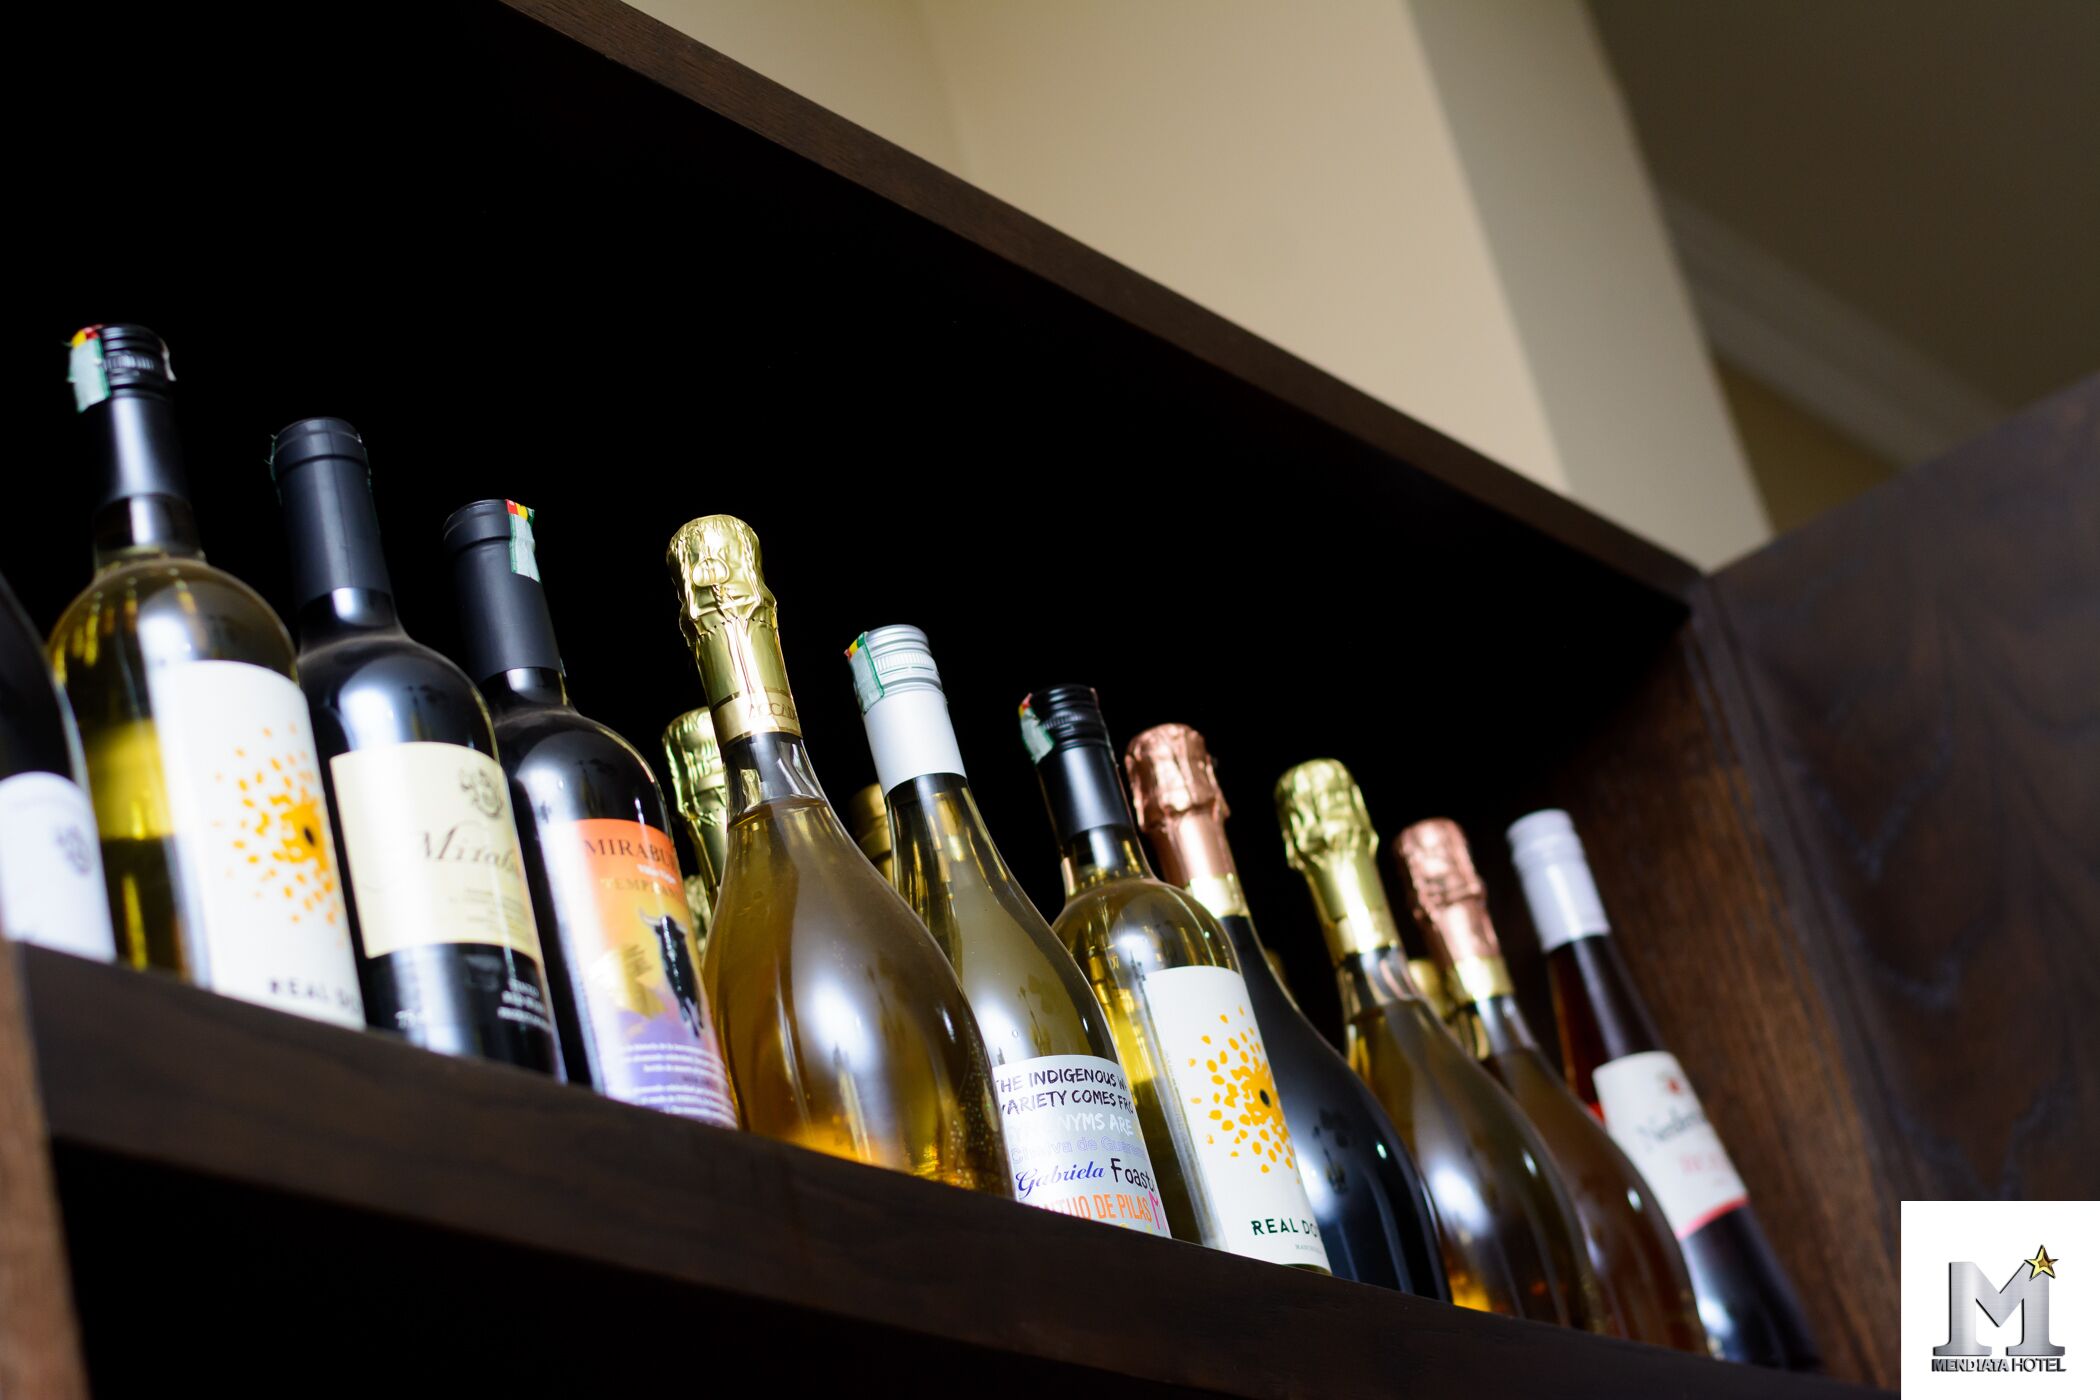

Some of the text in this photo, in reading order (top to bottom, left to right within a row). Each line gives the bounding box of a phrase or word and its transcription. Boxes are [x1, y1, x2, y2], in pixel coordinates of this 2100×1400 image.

[1028, 1067, 1116, 1088] INDIGENOUS
[1071, 1089, 1117, 1108] COMES
[1109, 1113, 1134, 1137] ARE
[1015, 1160, 1106, 1199] Gabriela
[1093, 1193, 1117, 1219] DE
[1115, 1193, 1153, 1223] PILAS
[1251, 1217, 1299, 1236] REAL
